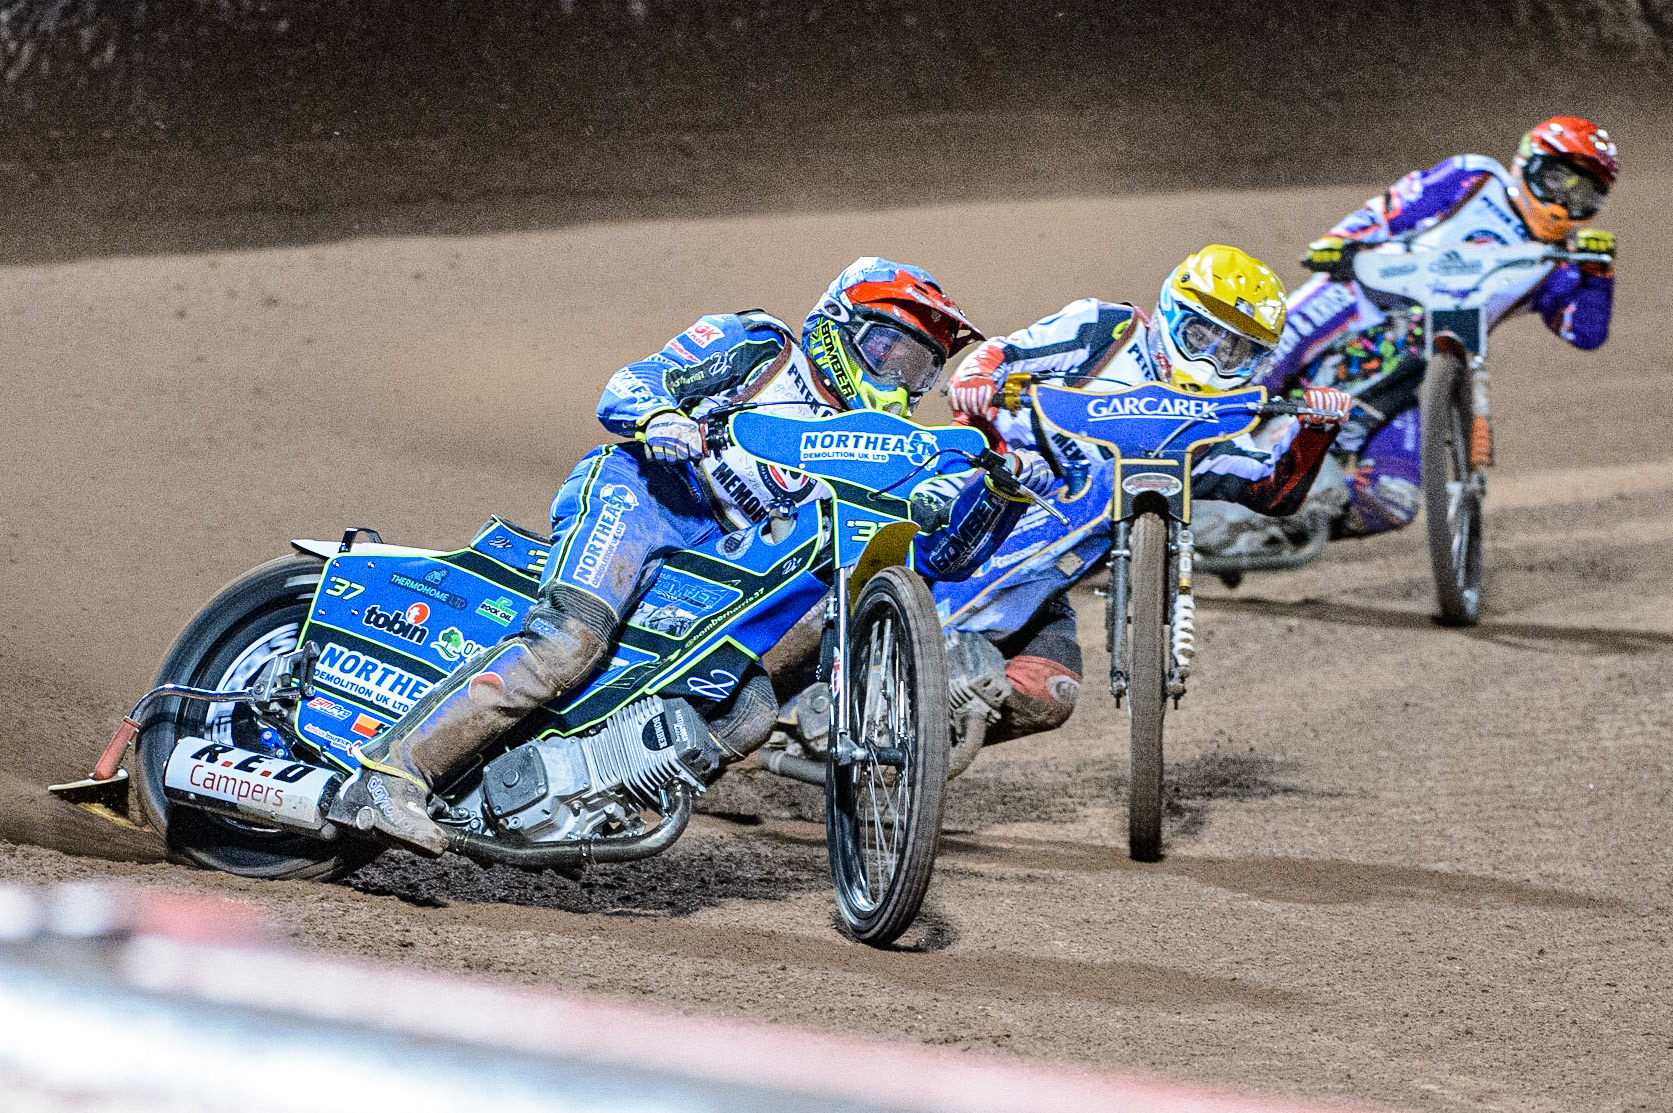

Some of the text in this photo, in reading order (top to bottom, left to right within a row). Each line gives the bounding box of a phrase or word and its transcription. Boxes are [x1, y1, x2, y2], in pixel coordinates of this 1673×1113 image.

[690, 324, 720, 341] GK
[821, 321, 856, 399] BOMBER
[787, 362, 821, 415] PETER
[1087, 396, 1220, 420] GARCAREK
[803, 433, 931, 456] NORTHEAST
[803, 451, 853, 459] DEMOLITION
[576, 493, 627, 581] NORTHEAST
[325, 576, 366, 600] 37
[391, 574, 466, 609] THERMOHOME LTD
[364, 603, 430, 644] tobin
[480, 603, 512, 622] ROCK OIL
[313, 668, 409, 713] DEMOLITION UK LTD
[651, 715, 668, 749] BOMBER
[190, 764, 285, 807] Campers
